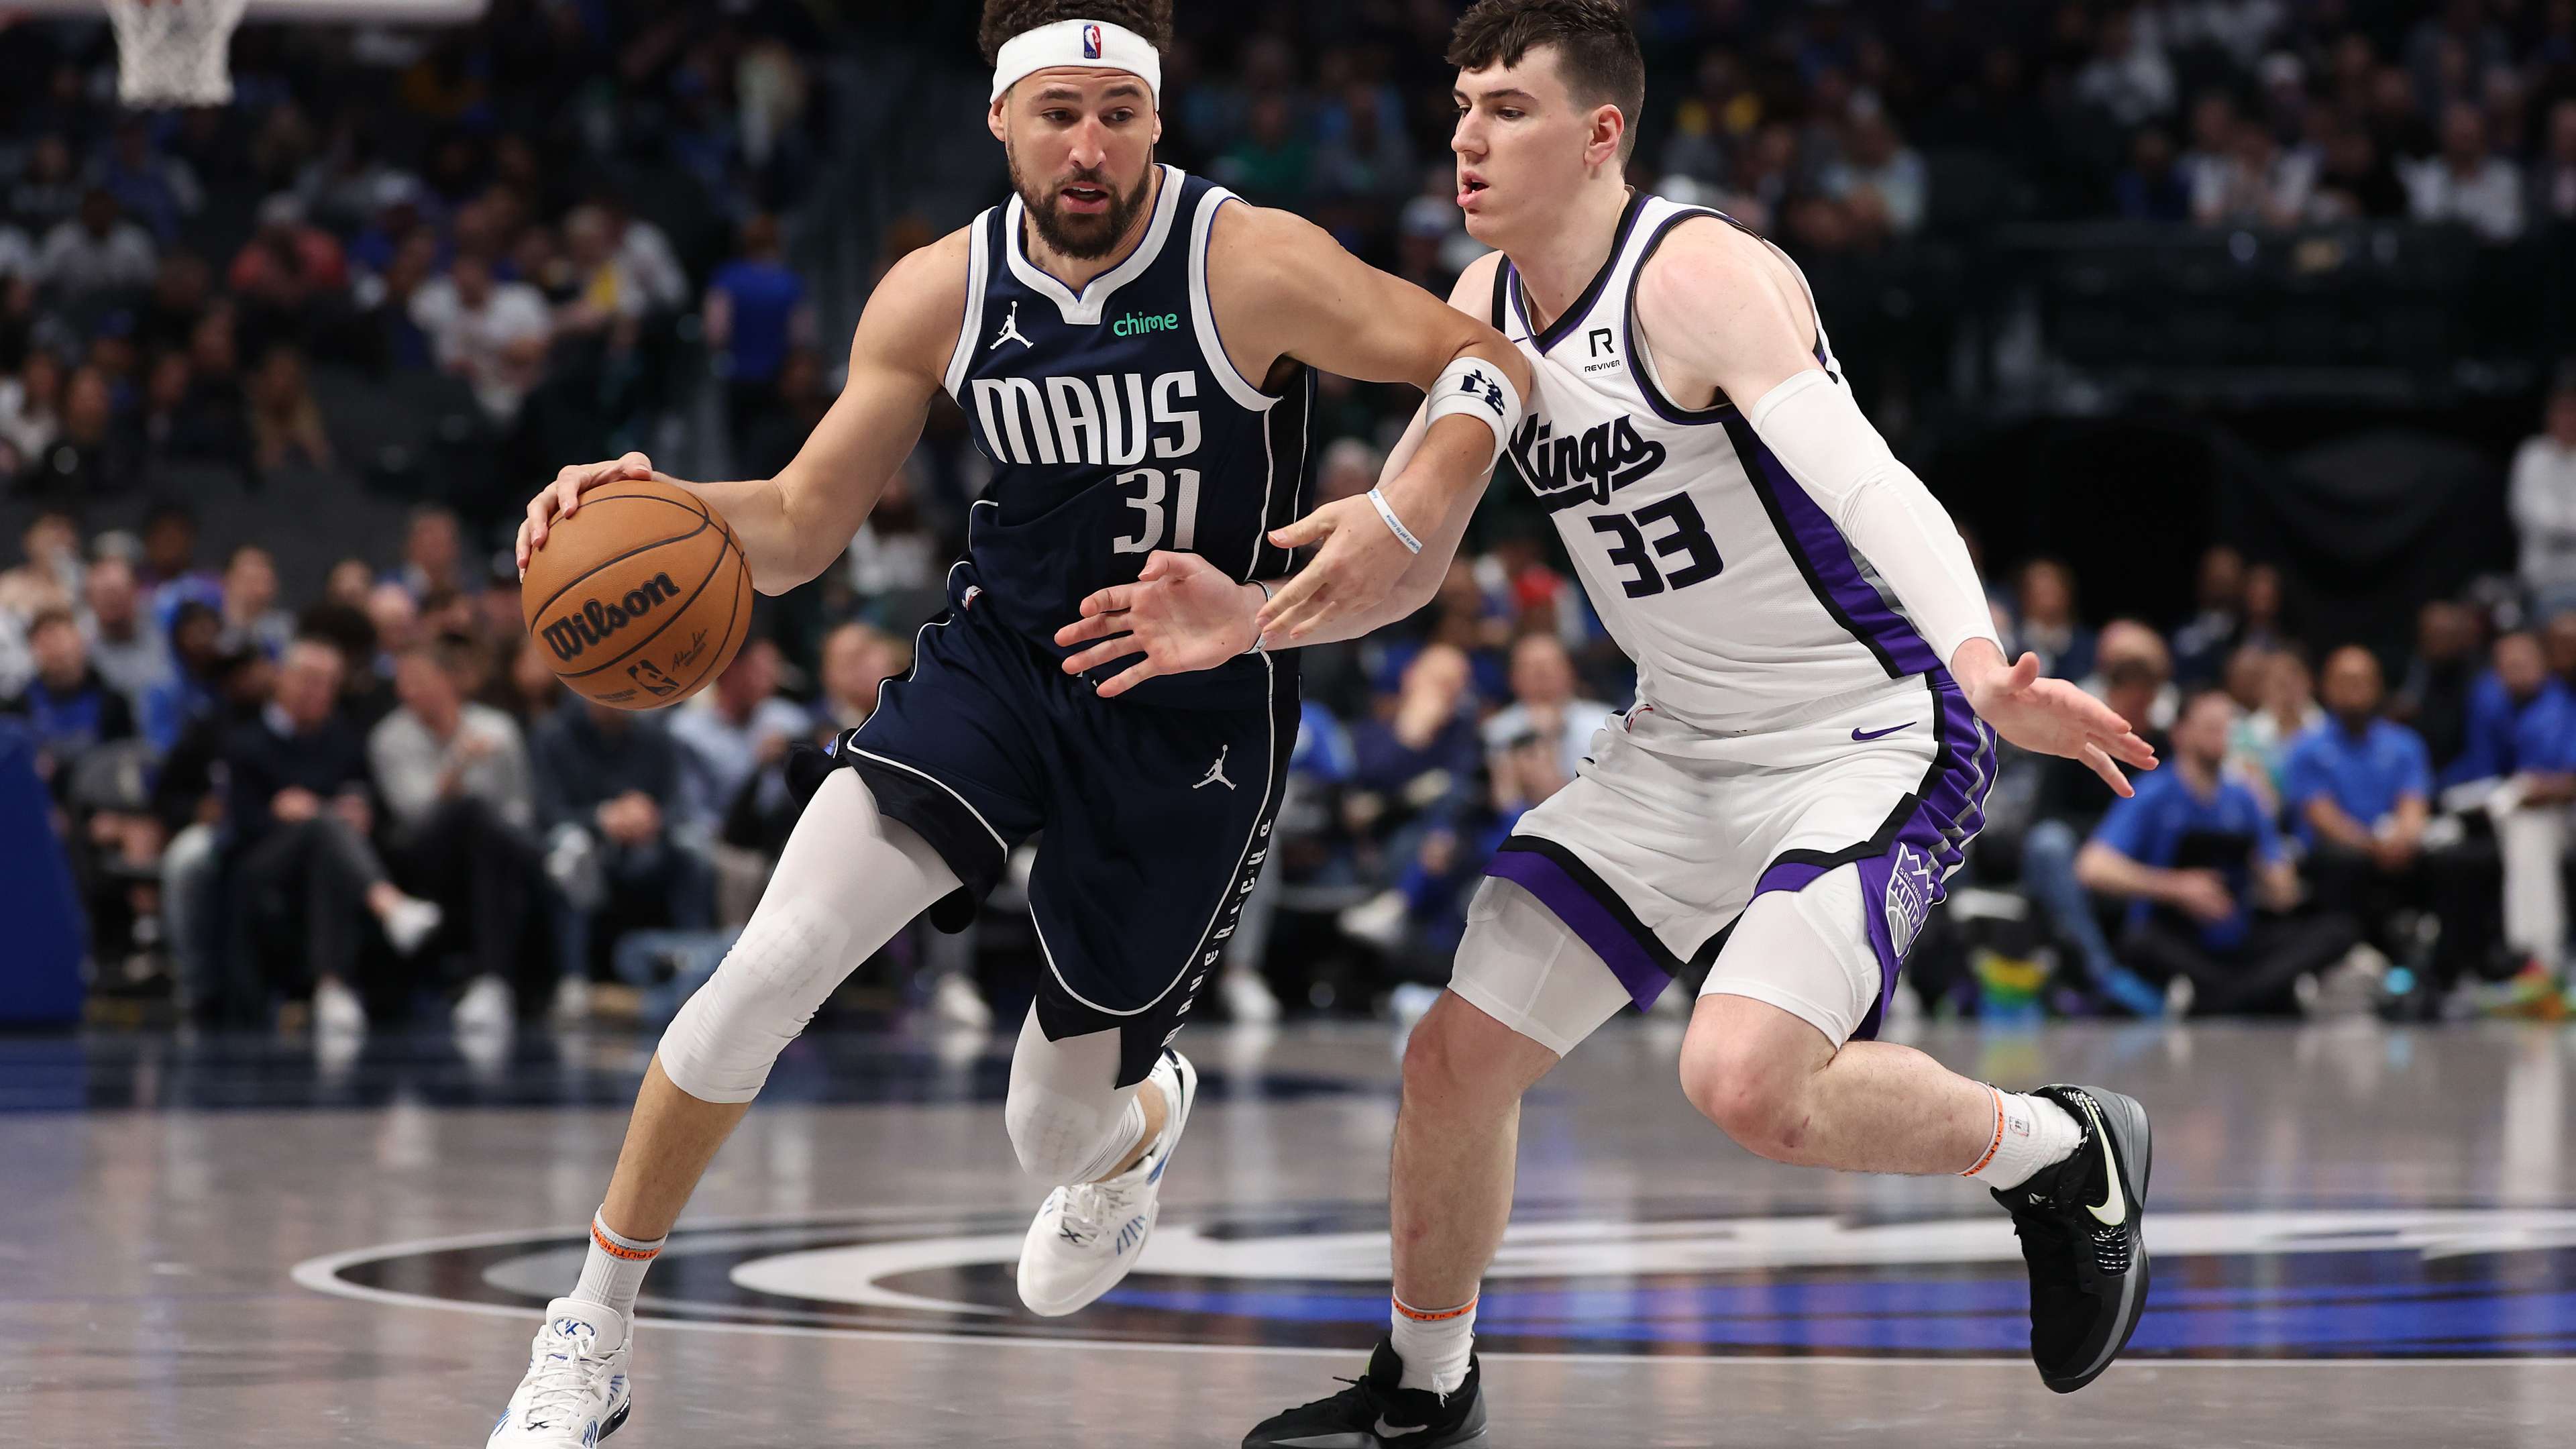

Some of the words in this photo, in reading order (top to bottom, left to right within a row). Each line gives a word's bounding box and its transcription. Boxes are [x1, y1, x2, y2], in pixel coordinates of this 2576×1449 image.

[1113, 311, 1179, 337] chime
[1585, 360, 1620, 372] REVIVER
[1589, 328, 1614, 357] R
[971, 370, 1201, 466] MAVS
[1509, 413, 1666, 514] Kings
[1114, 468, 1201, 555] 31
[1588, 491, 1724, 598] 33
[542, 572, 680, 662] Wilson
